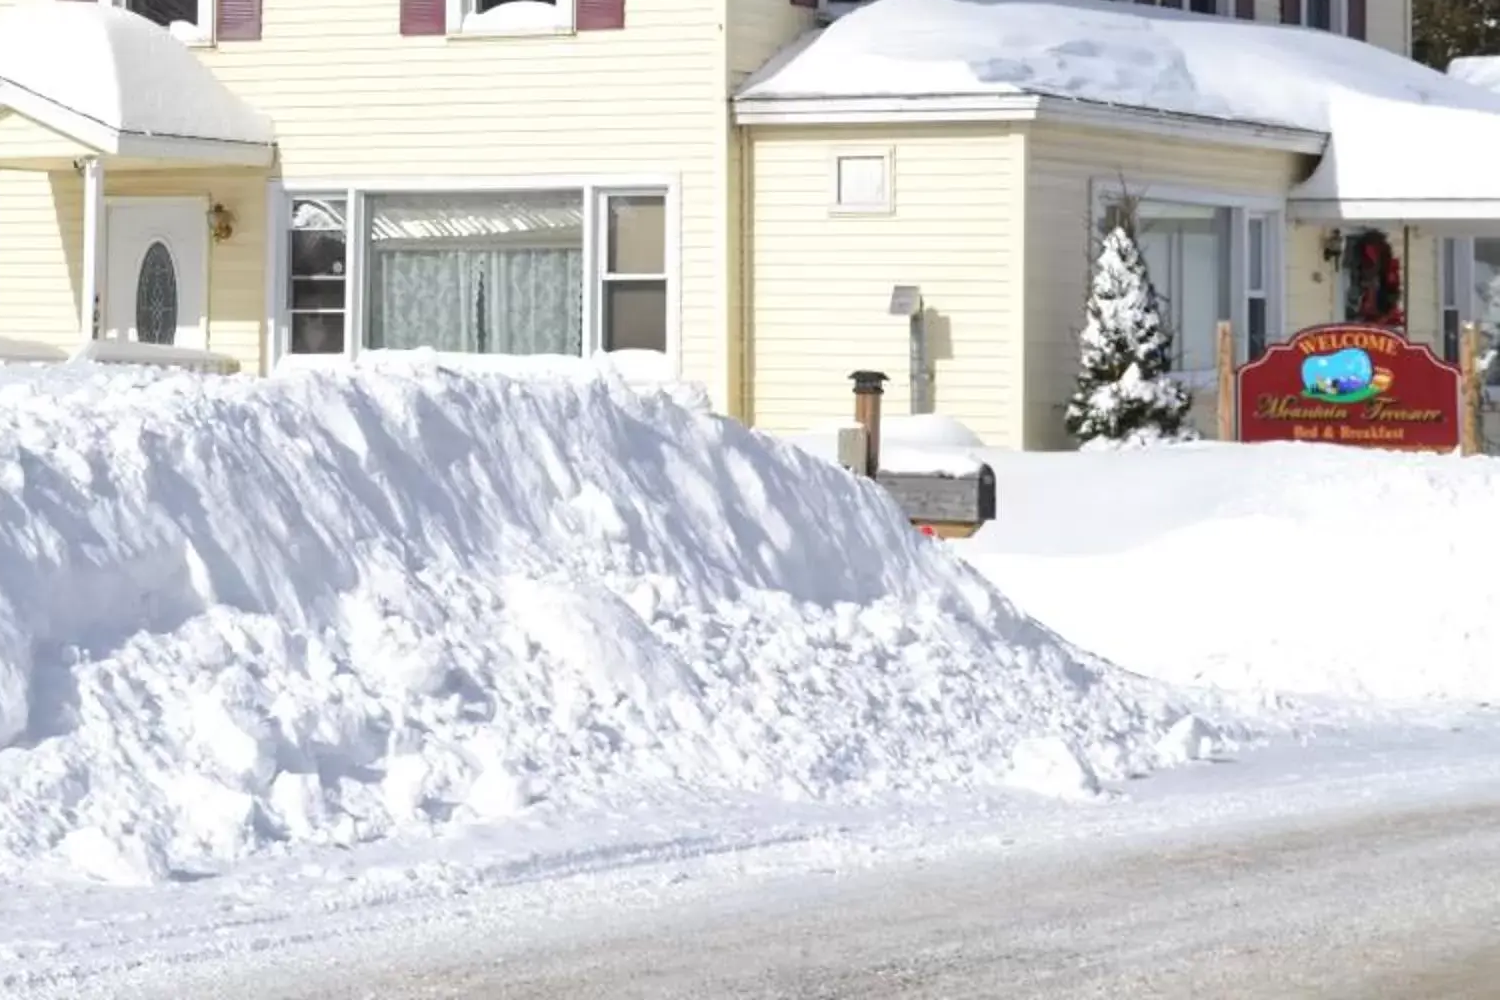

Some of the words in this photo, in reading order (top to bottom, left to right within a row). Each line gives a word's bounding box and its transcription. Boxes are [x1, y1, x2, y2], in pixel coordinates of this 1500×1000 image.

[1299, 332, 1398, 356] WELCOME
[1253, 394, 1348, 420] Mountain
[1293, 425, 1318, 439] Bed
[1323, 425, 1334, 439] &
[1340, 425, 1404, 440] Breakfast
